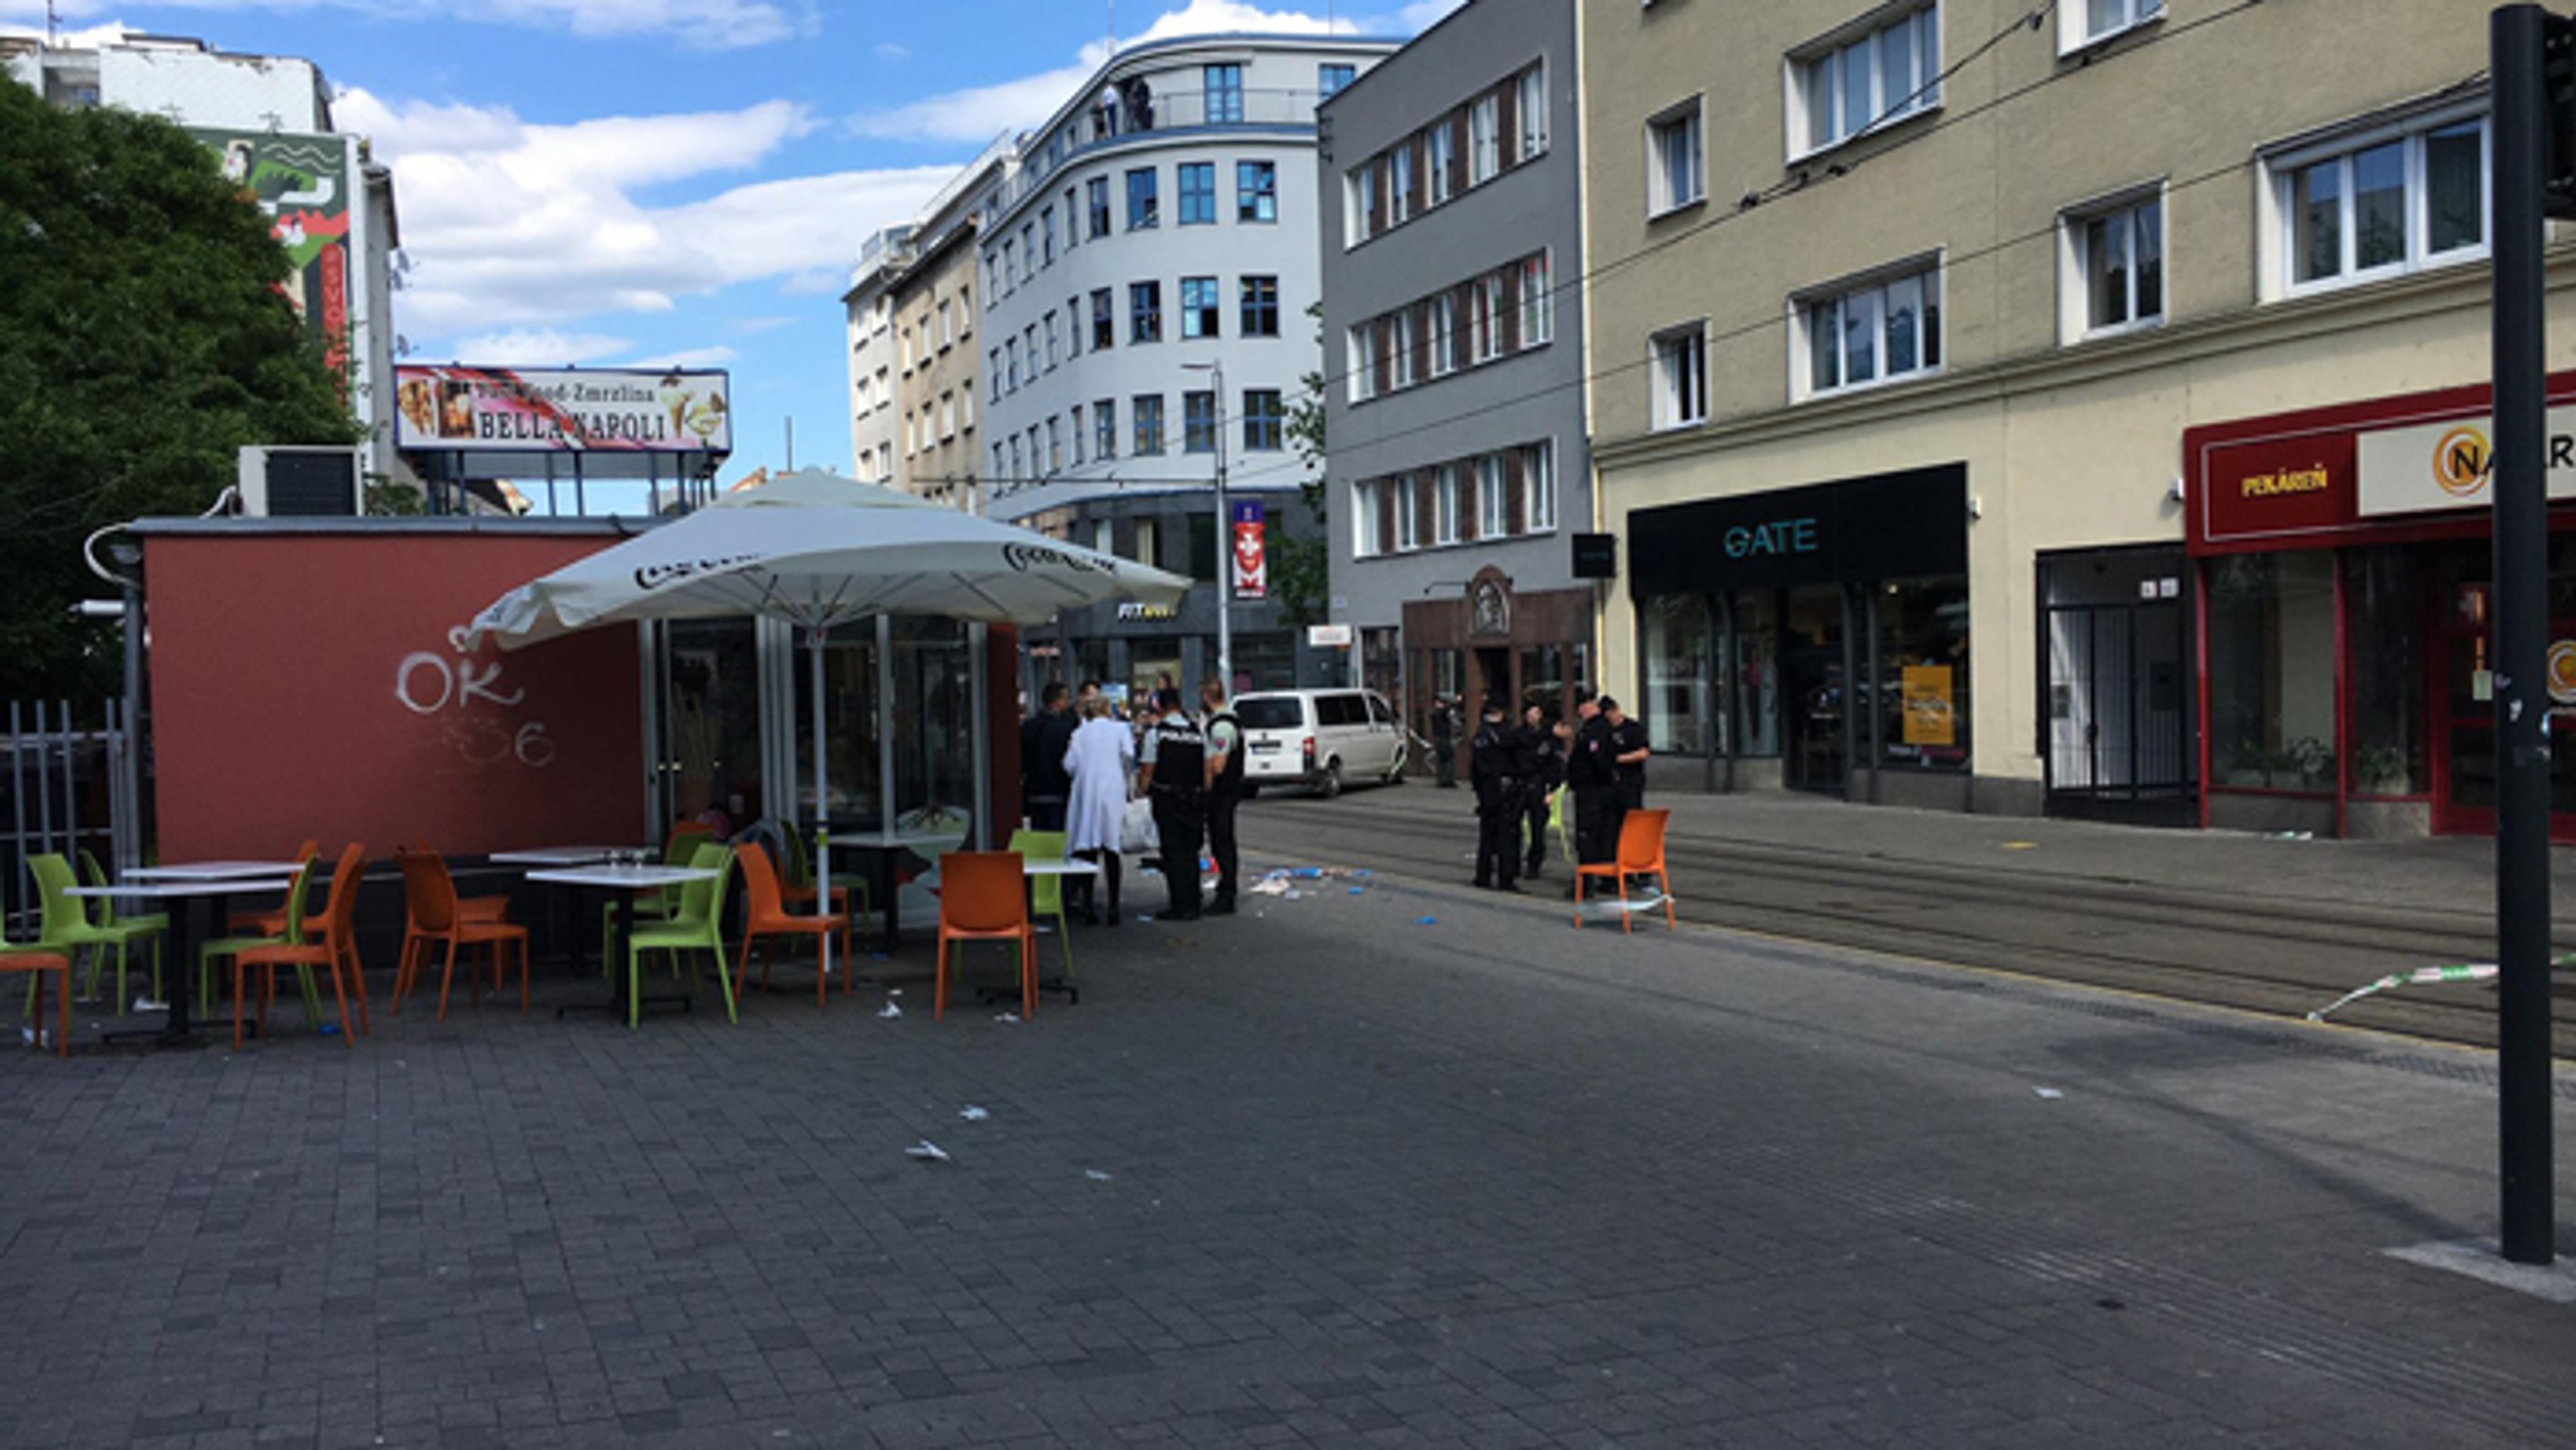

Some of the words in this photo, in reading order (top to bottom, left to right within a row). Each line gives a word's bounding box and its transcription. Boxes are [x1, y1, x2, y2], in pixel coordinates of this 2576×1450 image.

[479, 412, 564, 440] BELLA
[574, 413, 665, 442] NAPOLI
[1725, 519, 1817, 557] GATE
[396, 651, 525, 714] OK
